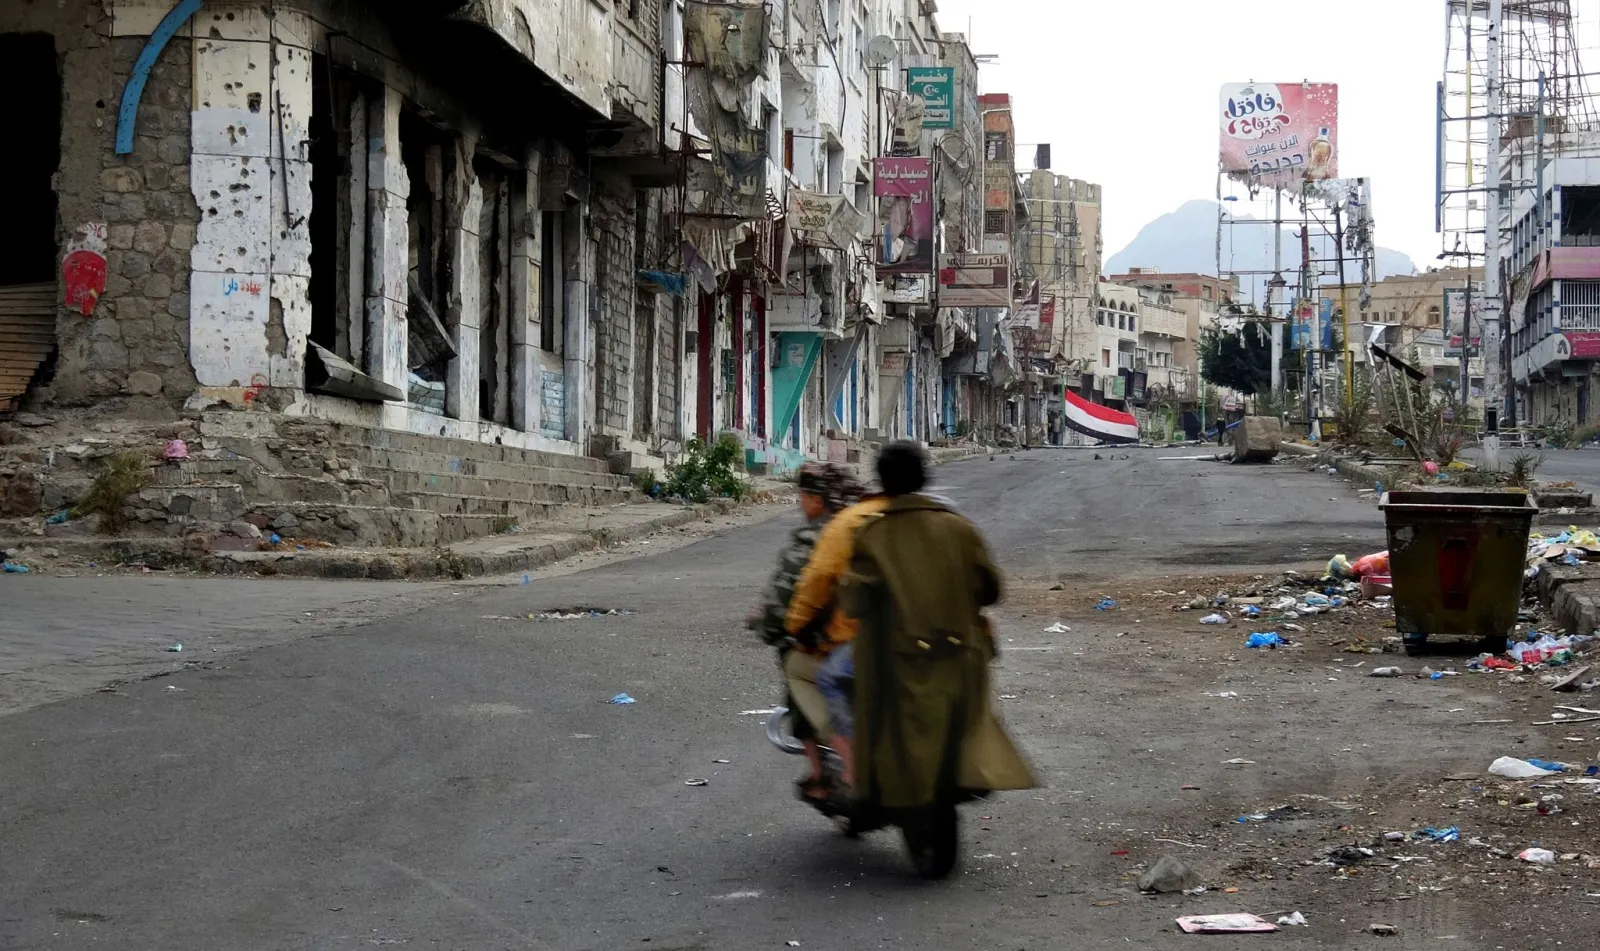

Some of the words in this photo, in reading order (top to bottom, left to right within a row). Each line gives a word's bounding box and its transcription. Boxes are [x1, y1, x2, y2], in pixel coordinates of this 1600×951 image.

[911, 69, 948, 86] مختبر
[1228, 93, 1276, 117] فانتا
[1240, 117, 1270, 134] تفاح
[1245, 143, 1277, 156] عبوات
[877, 162, 929, 184] صيدلية
